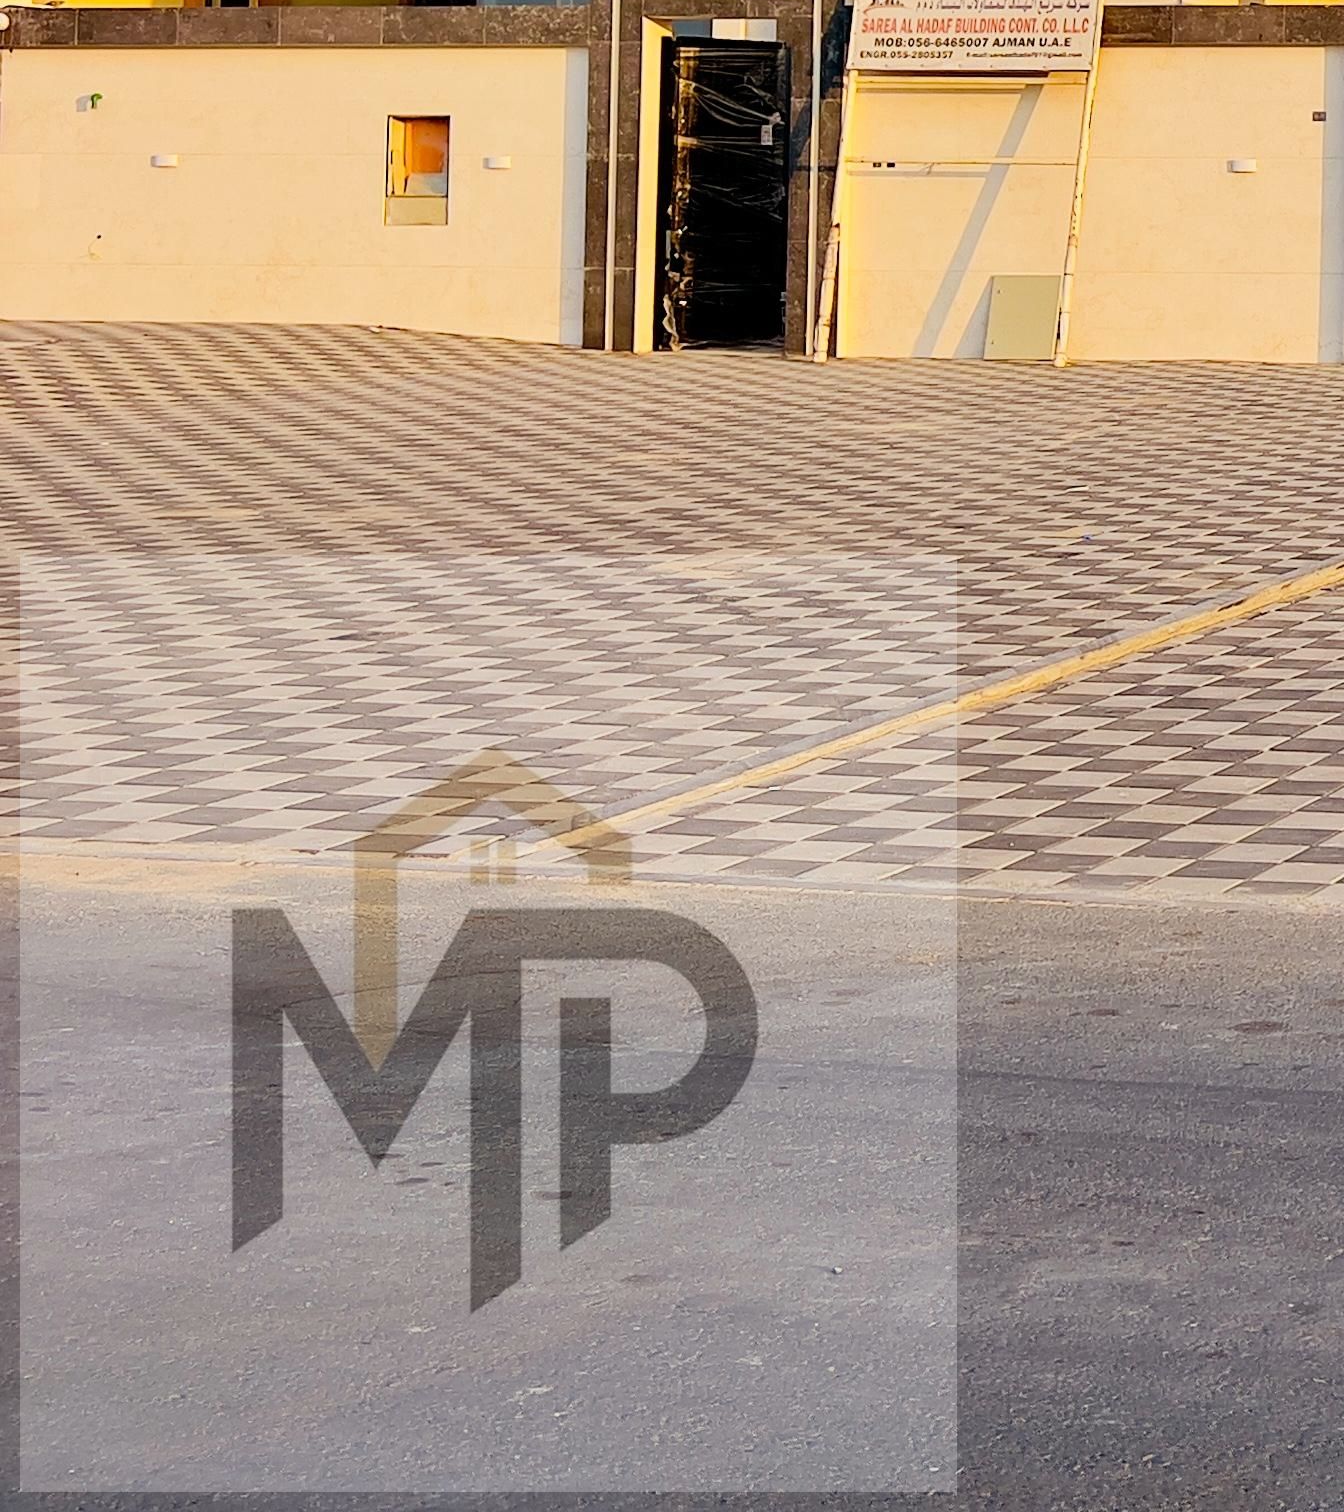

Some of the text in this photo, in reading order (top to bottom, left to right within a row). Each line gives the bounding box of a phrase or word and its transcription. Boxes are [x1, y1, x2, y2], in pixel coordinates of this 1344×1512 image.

[1037, 0, 1063, 15] سريع
[862, 18, 897, 33] SAREA
[900, 18, 913, 33] AL
[916, 18, 953, 33] HADAF
[955, 18, 1006, 33] BUILDING
[1009, 18, 1039, 33] CONT.
[1042, 18, 1060, 33] CO.
[874, 37, 1072, 48] MOB:056-6465007 AJMAN U.A.E
